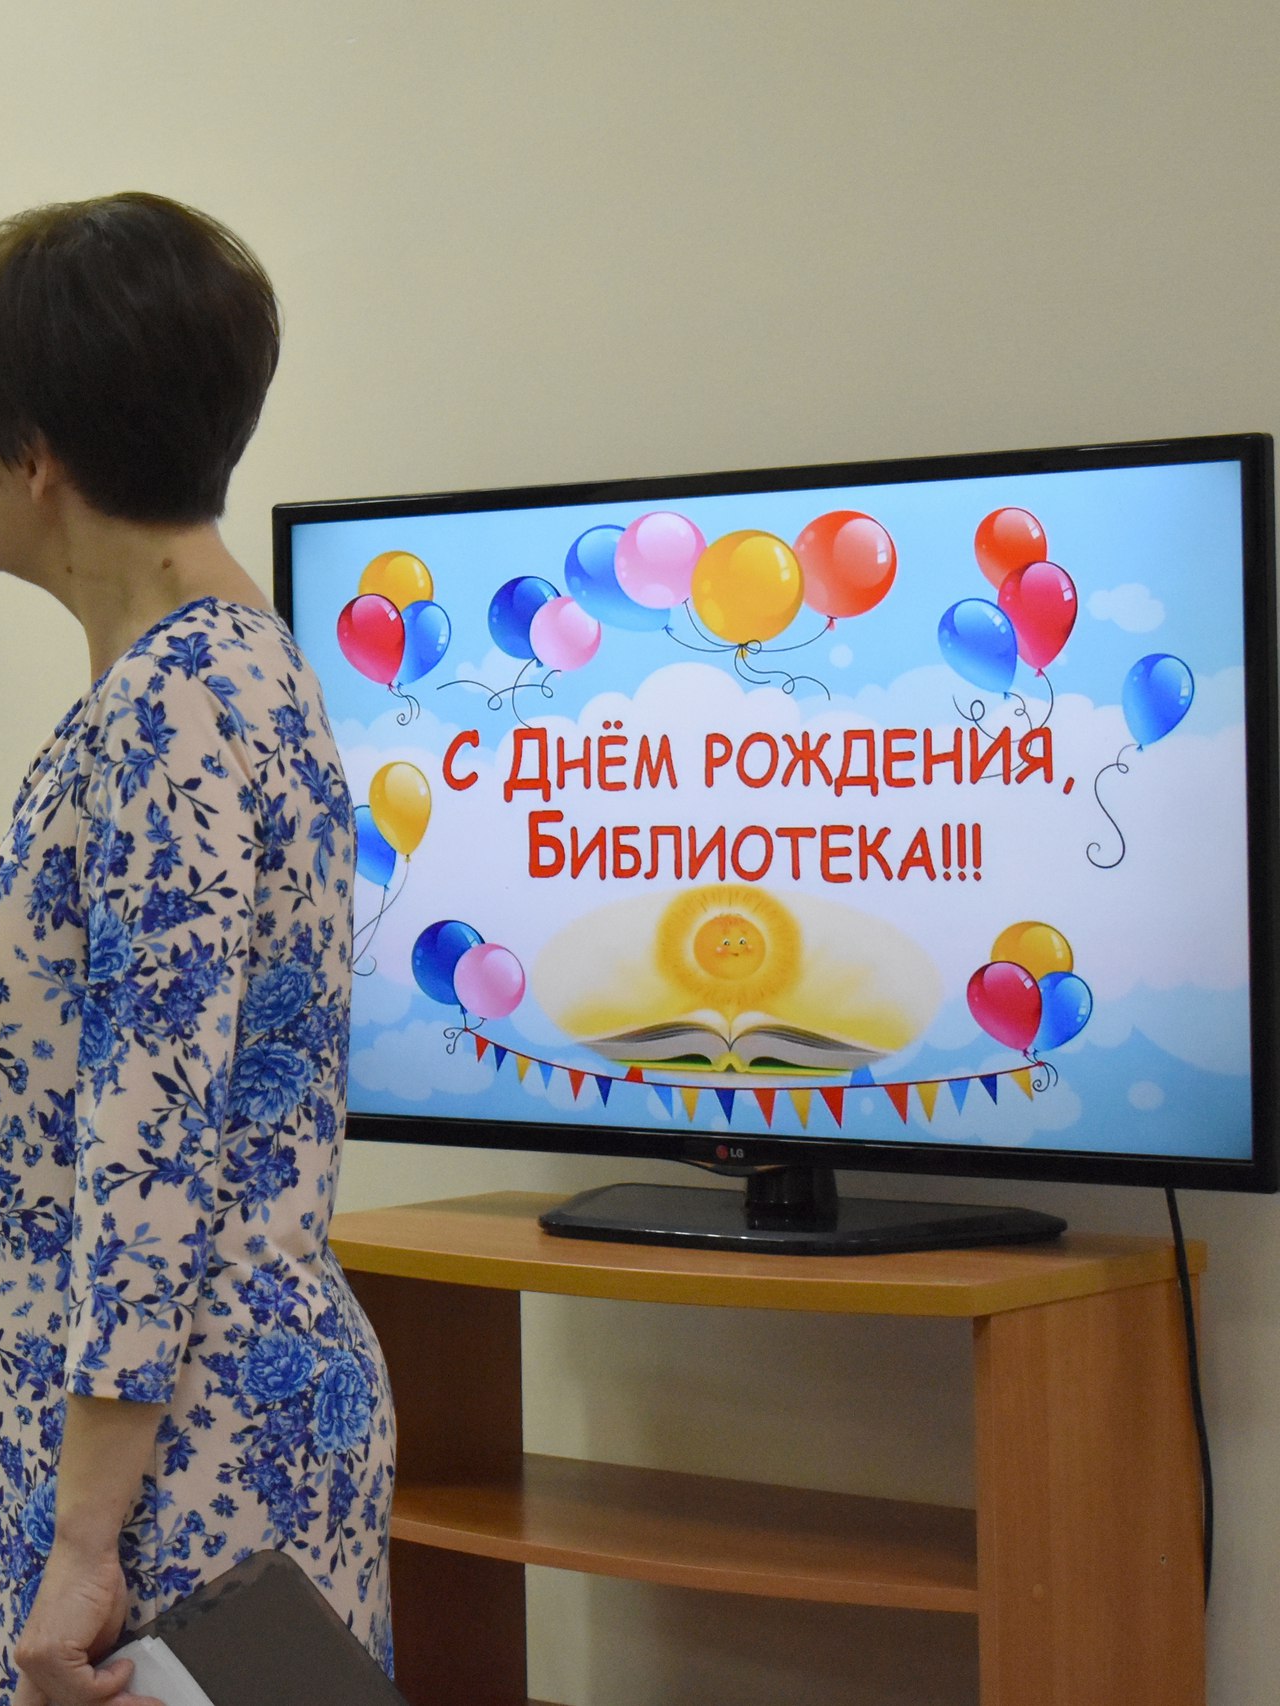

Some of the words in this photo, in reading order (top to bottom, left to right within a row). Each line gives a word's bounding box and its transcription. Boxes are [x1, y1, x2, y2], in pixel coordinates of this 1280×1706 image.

[442, 729, 480, 791] С
[503, 720, 679, 802] ДНЁМ
[704, 727, 1075, 797] РОЖДЕНИЯ,
[527, 809, 983, 884] БИБЛИОТЕКА!!!
[729, 1147, 744, 1159] LG
